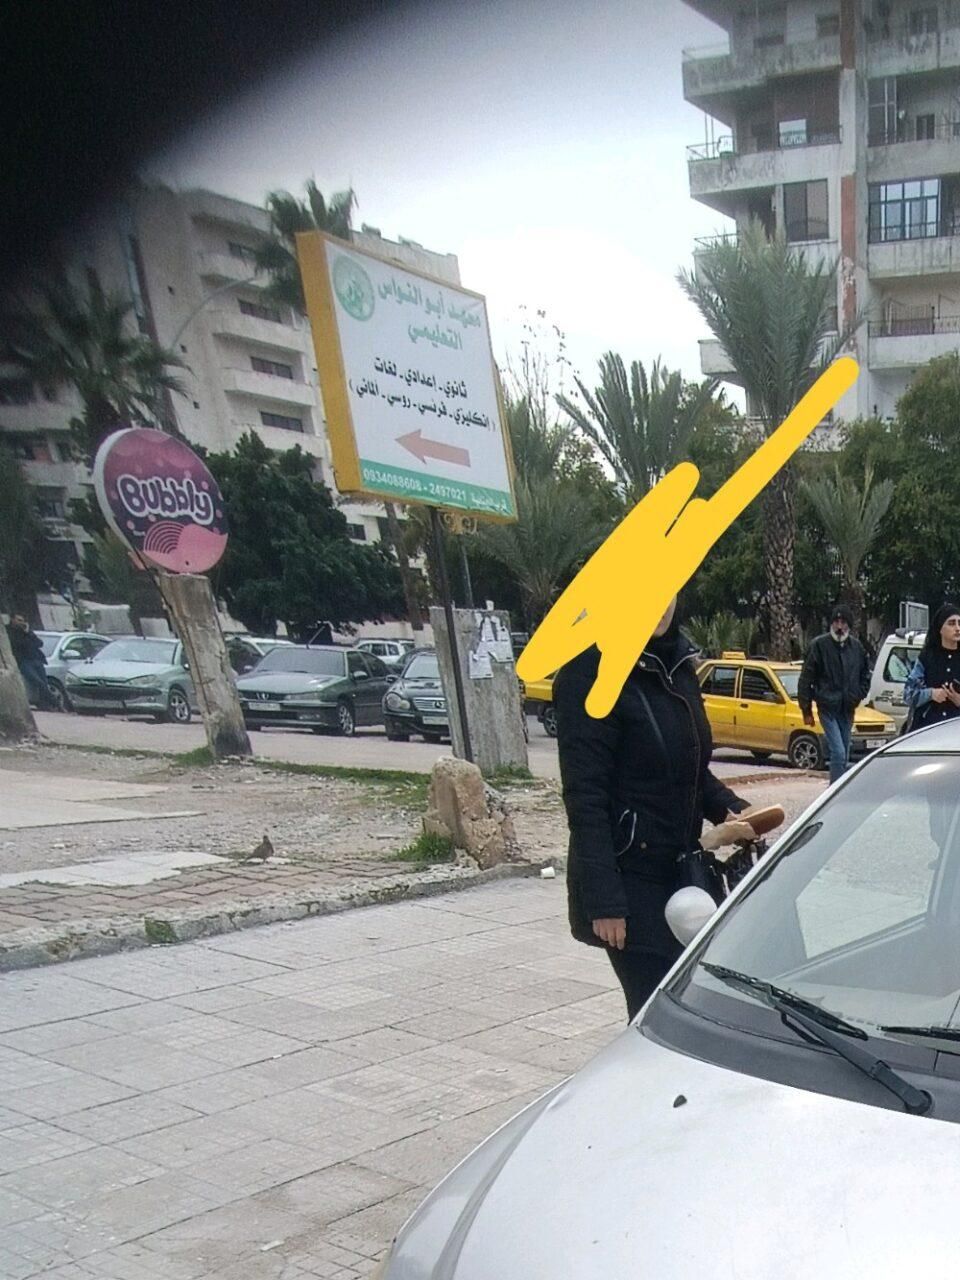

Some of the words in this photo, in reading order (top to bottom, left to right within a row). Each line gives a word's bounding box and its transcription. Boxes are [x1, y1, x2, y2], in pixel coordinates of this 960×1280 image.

[408, 324, 463, 350] التعليمي
[374, 357, 397, 376] لغات
[443, 380, 468, 399] ثانوي
[418, 399, 447, 418] فرنسي
[117, 474, 213, 525] Bubbly
